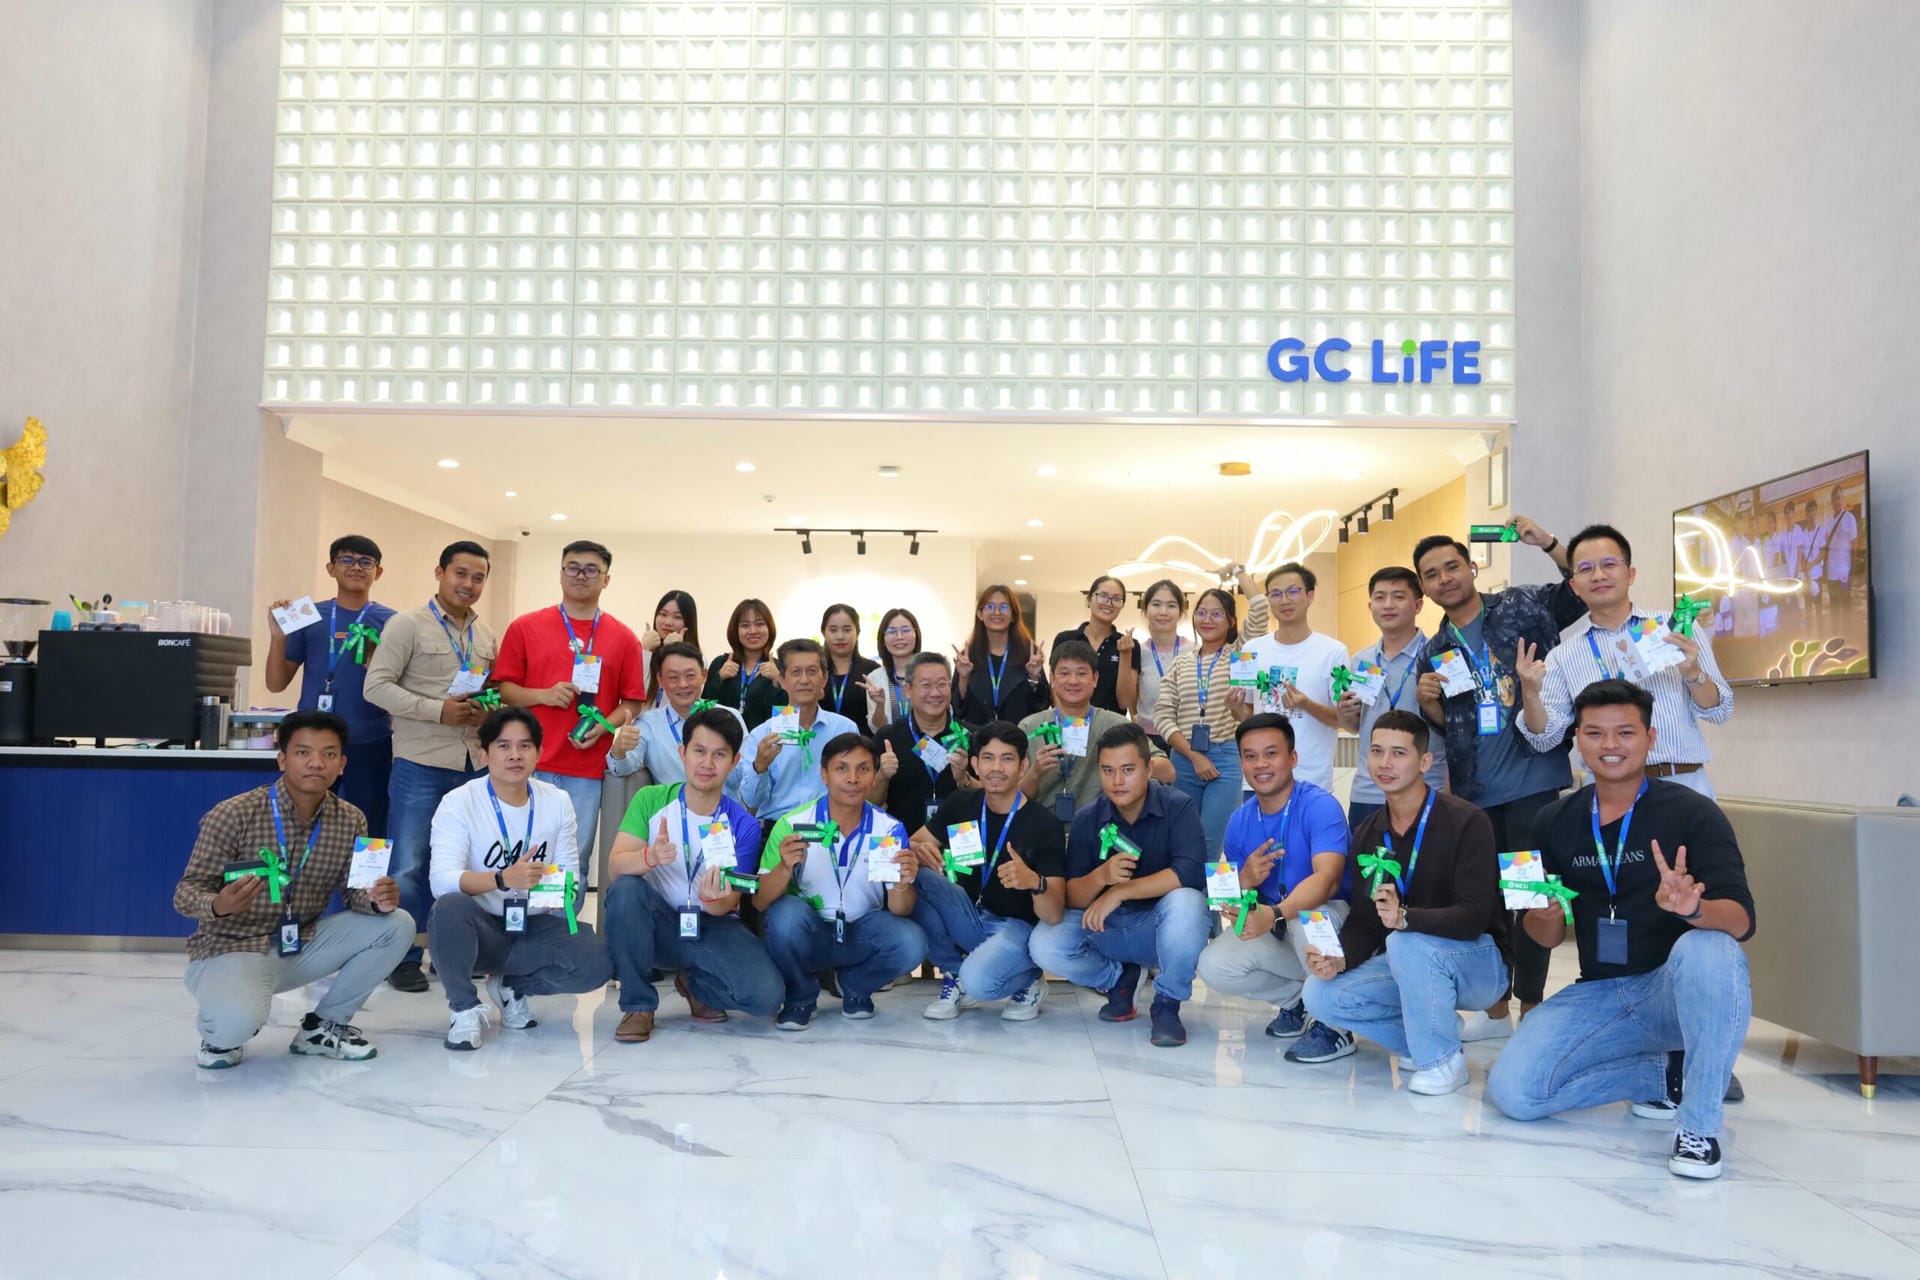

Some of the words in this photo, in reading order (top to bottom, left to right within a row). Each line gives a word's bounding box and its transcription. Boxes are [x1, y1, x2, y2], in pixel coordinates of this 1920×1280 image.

[1267, 337, 1352, 382] GC
[1372, 339, 1481, 384] LiFE
[484, 840, 547, 869] OSAA
[1572, 854, 1613, 868] ARMAI
